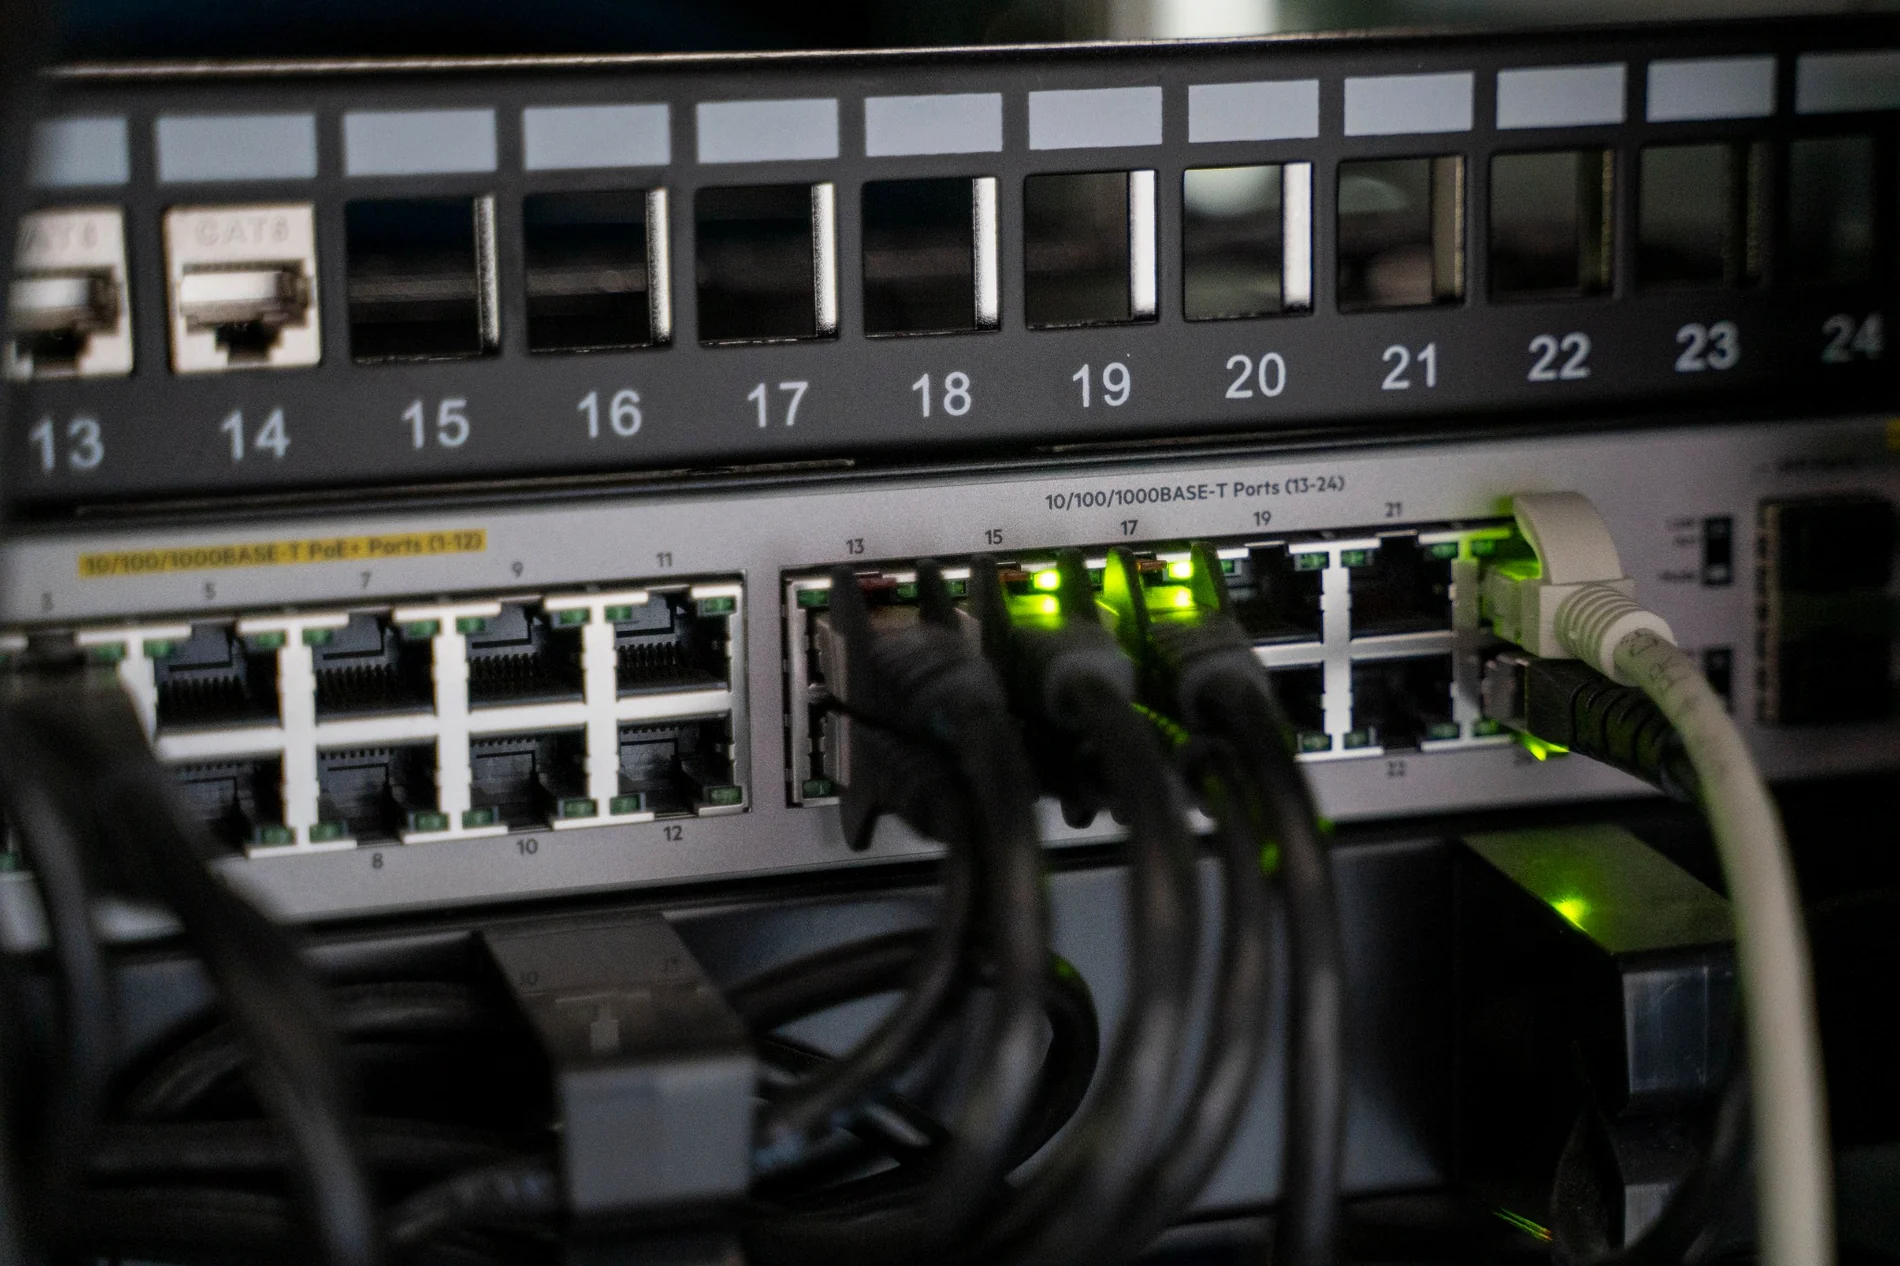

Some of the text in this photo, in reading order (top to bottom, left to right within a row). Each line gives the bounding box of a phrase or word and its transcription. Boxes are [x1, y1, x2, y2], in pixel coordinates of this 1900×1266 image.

[194, 215, 291, 246] CAT6
[1674, 323, 1737, 372] 23
[1823, 315, 1882, 362] 24
[1382, 343, 1436, 390] 21
[1528, 333, 1589, 381] 22
[1072, 362, 1131, 408] 19
[1225, 352, 1286, 399] 20
[747, 380, 809, 428] 17
[912, 371, 972, 418] 18
[403, 398, 470, 448] 15
[578, 389, 642, 438] 16
[30, 417, 104, 470] 13
[222, 409, 290, 460] 14
[1045, 475, 1345, 511] 10/100/1000BASE-T Ports (13-24)
[1385, 501, 1403, 518] 21
[985, 528, 1004, 545] 15
[1120, 519, 1139, 536] 17
[1253, 510, 1272, 527] 19
[84, 528, 483, 577] 10/100/1000BASE-T PoE+ Ports (1-12)
[656, 551, 673, 568] 11
[846, 538, 865, 556] 13
[361, 570, 372, 589] 7
[511, 561, 524, 579] 9
[205, 580, 216, 600] 5
[516, 838, 539, 856] 10
[663, 825, 683, 842] 12
[371, 852, 384, 870] 8
